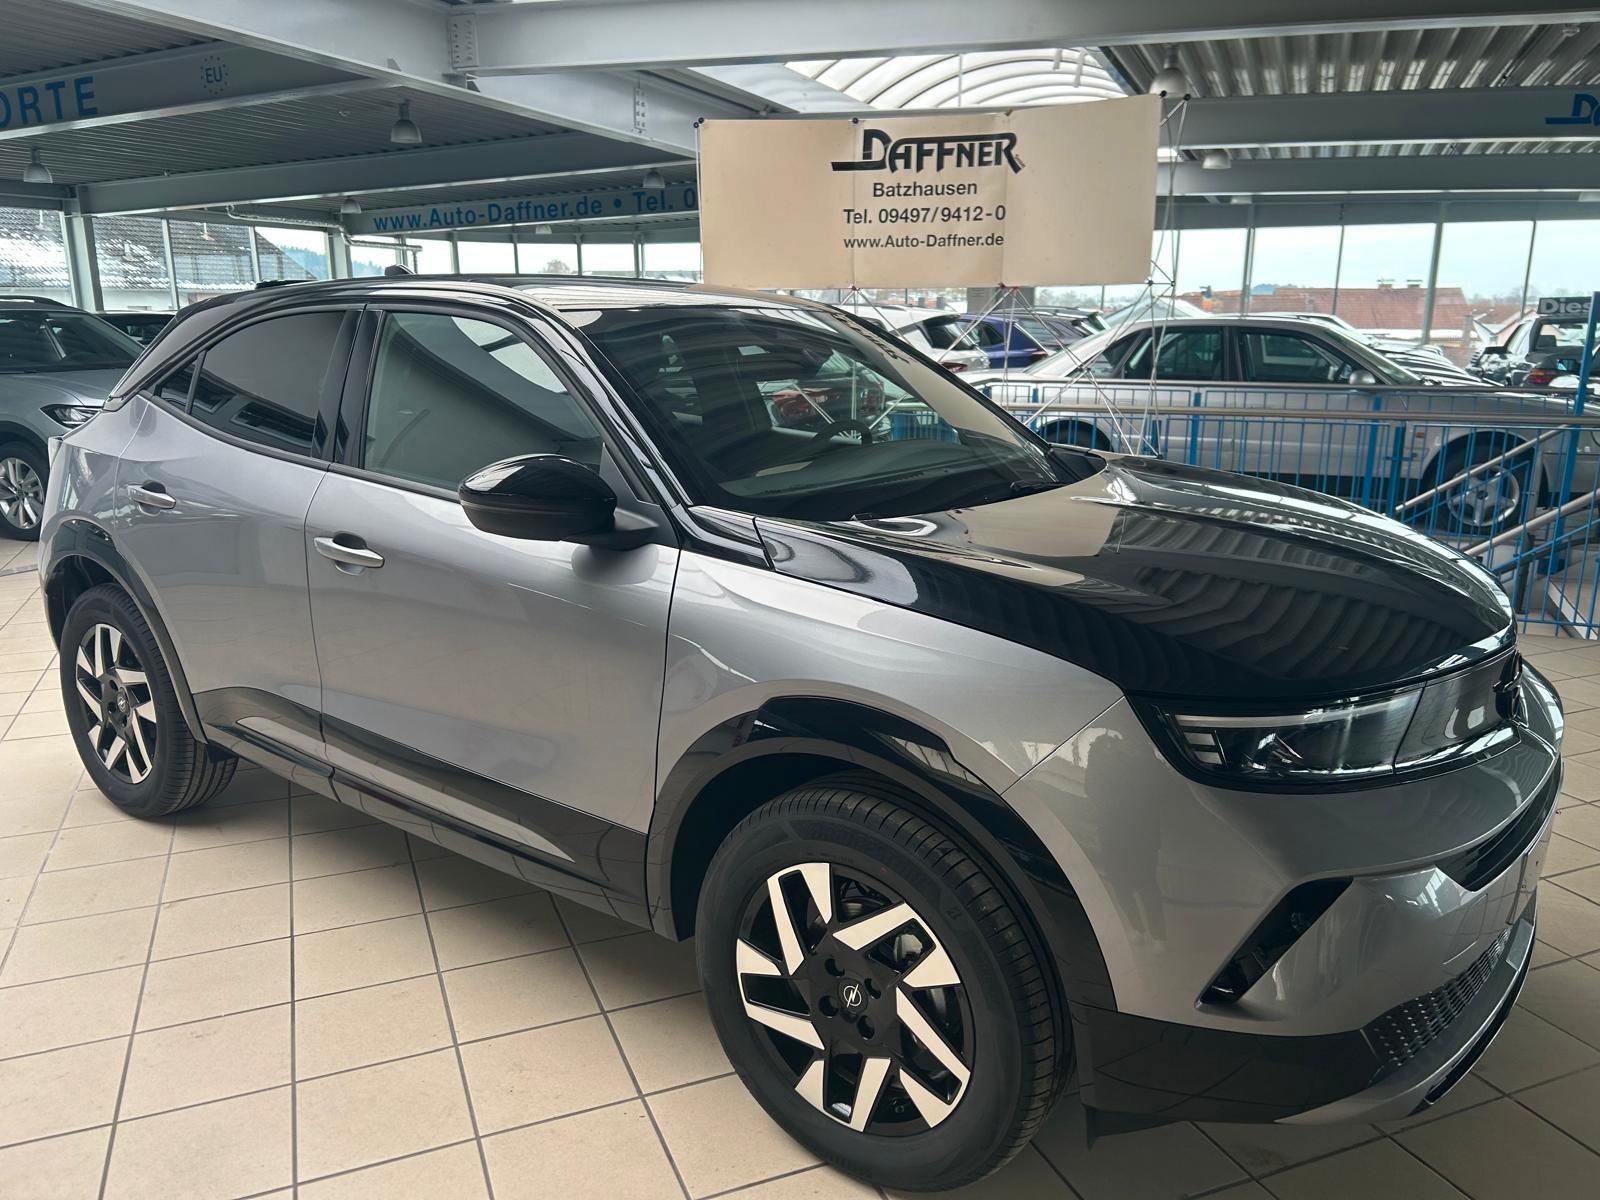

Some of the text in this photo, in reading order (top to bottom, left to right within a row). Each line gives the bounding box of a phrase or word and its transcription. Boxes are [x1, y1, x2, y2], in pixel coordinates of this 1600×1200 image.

[205, 67, 223, 83] EU
[831, 129, 1021, 174] DAFFNER
[873, 181, 978, 198] Batzhausen
[373, 196, 603, 231] www.Auto-Daffner.de
[632, 190, 673, 212] Tel.
[843, 205, 1006, 224] Tel. 09497/9412-0
[844, 233, 1005, 248] www.Auto-Daffner.de
